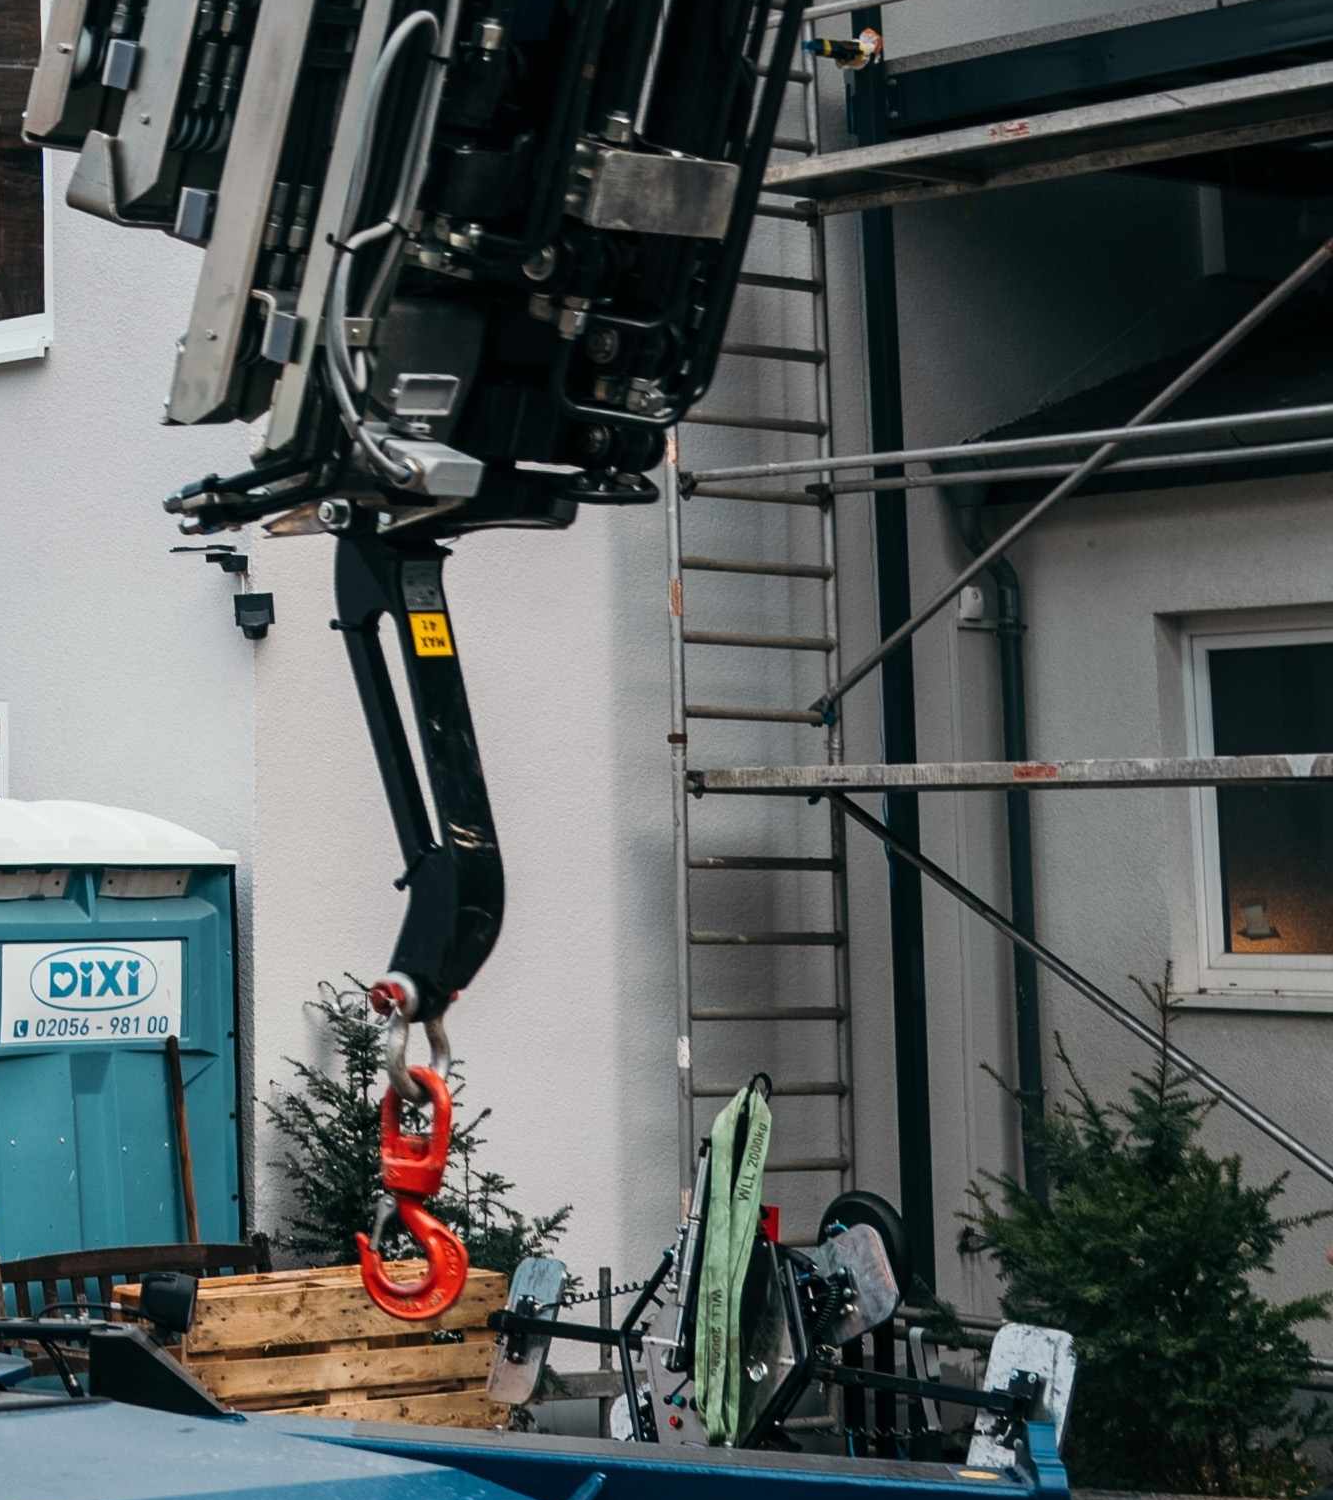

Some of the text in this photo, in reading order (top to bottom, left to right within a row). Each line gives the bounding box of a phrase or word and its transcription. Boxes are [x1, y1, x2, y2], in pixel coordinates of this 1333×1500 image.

[35, 1017, 90, 1037] 02056
[109, 1016, 140, 1036] 981
[145, 1014, 169, 1035] 00
[738, 1171, 756, 1201] WLL
